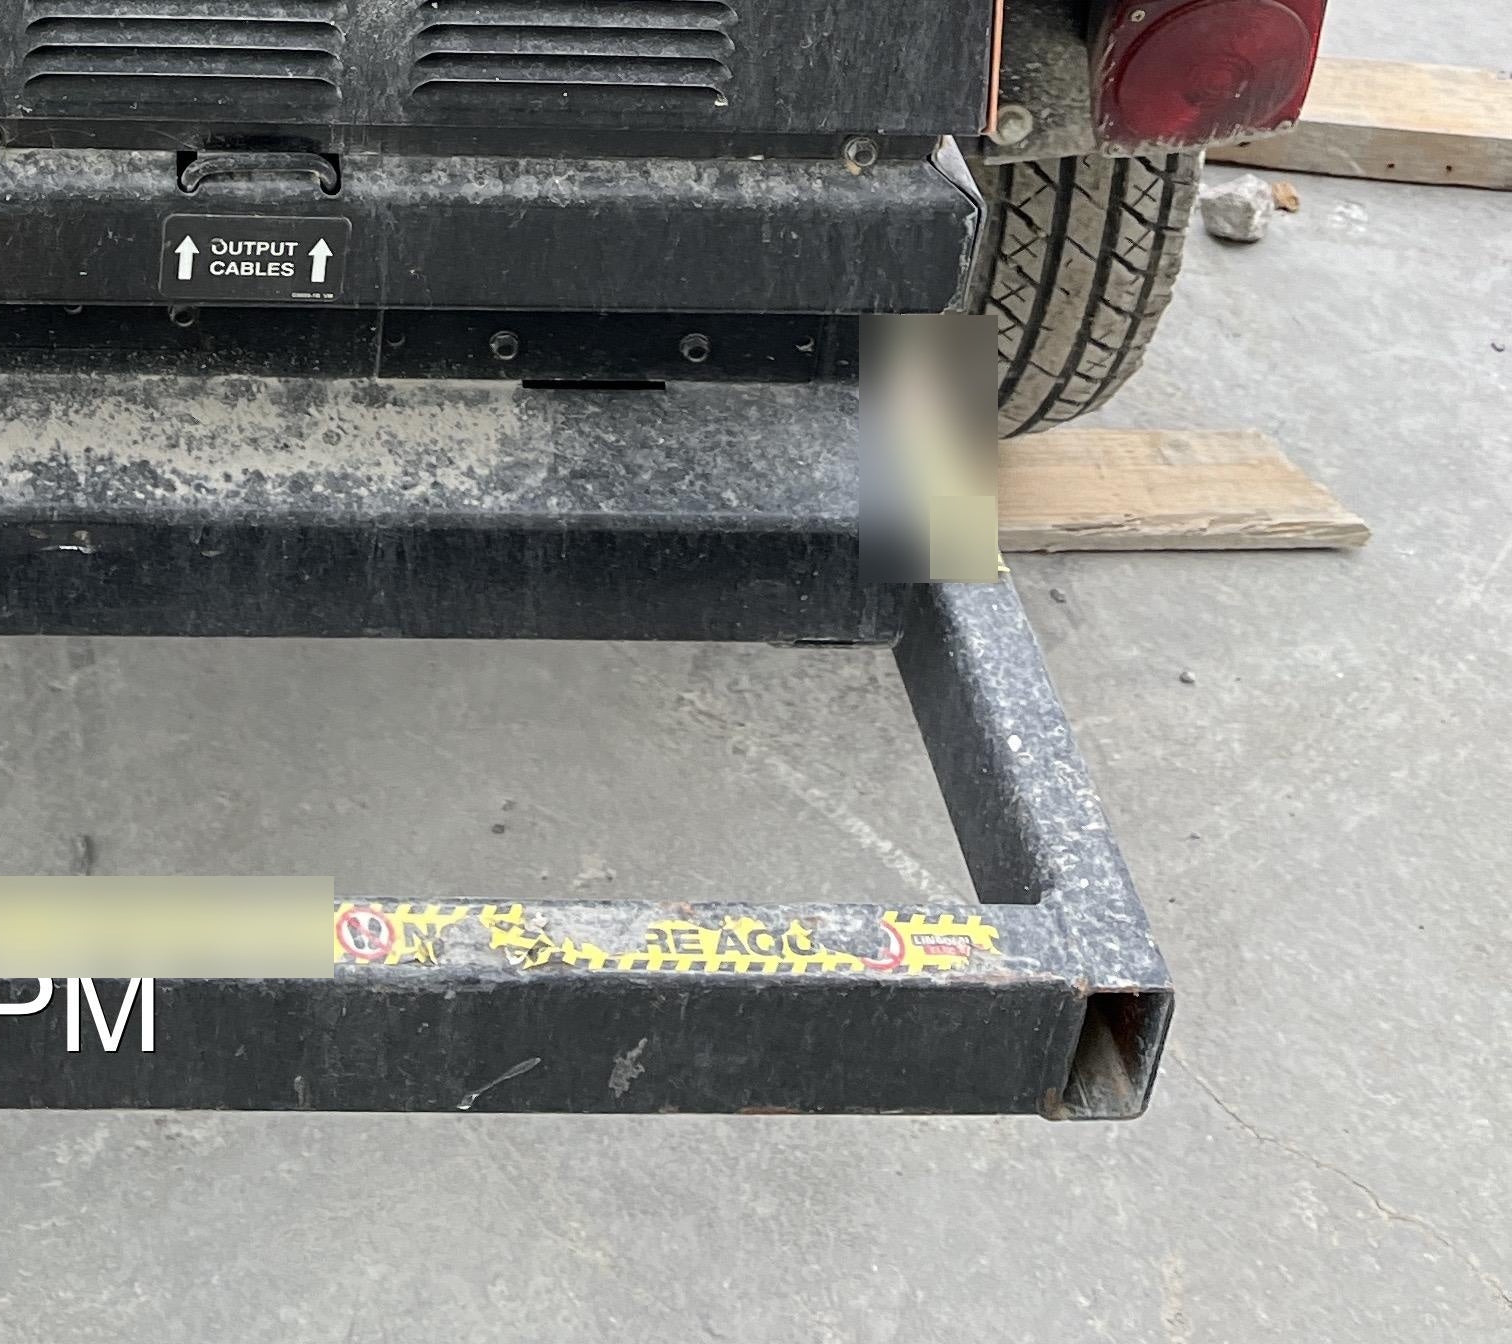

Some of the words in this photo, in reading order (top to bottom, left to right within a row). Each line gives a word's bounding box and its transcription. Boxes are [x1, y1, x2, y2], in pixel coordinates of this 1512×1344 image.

[210, 238, 299, 256] OUTPUT
[209, 261, 295, 277] CABLES
[643, 928, 705, 955] RE
[716, 928, 816, 958] AQU
